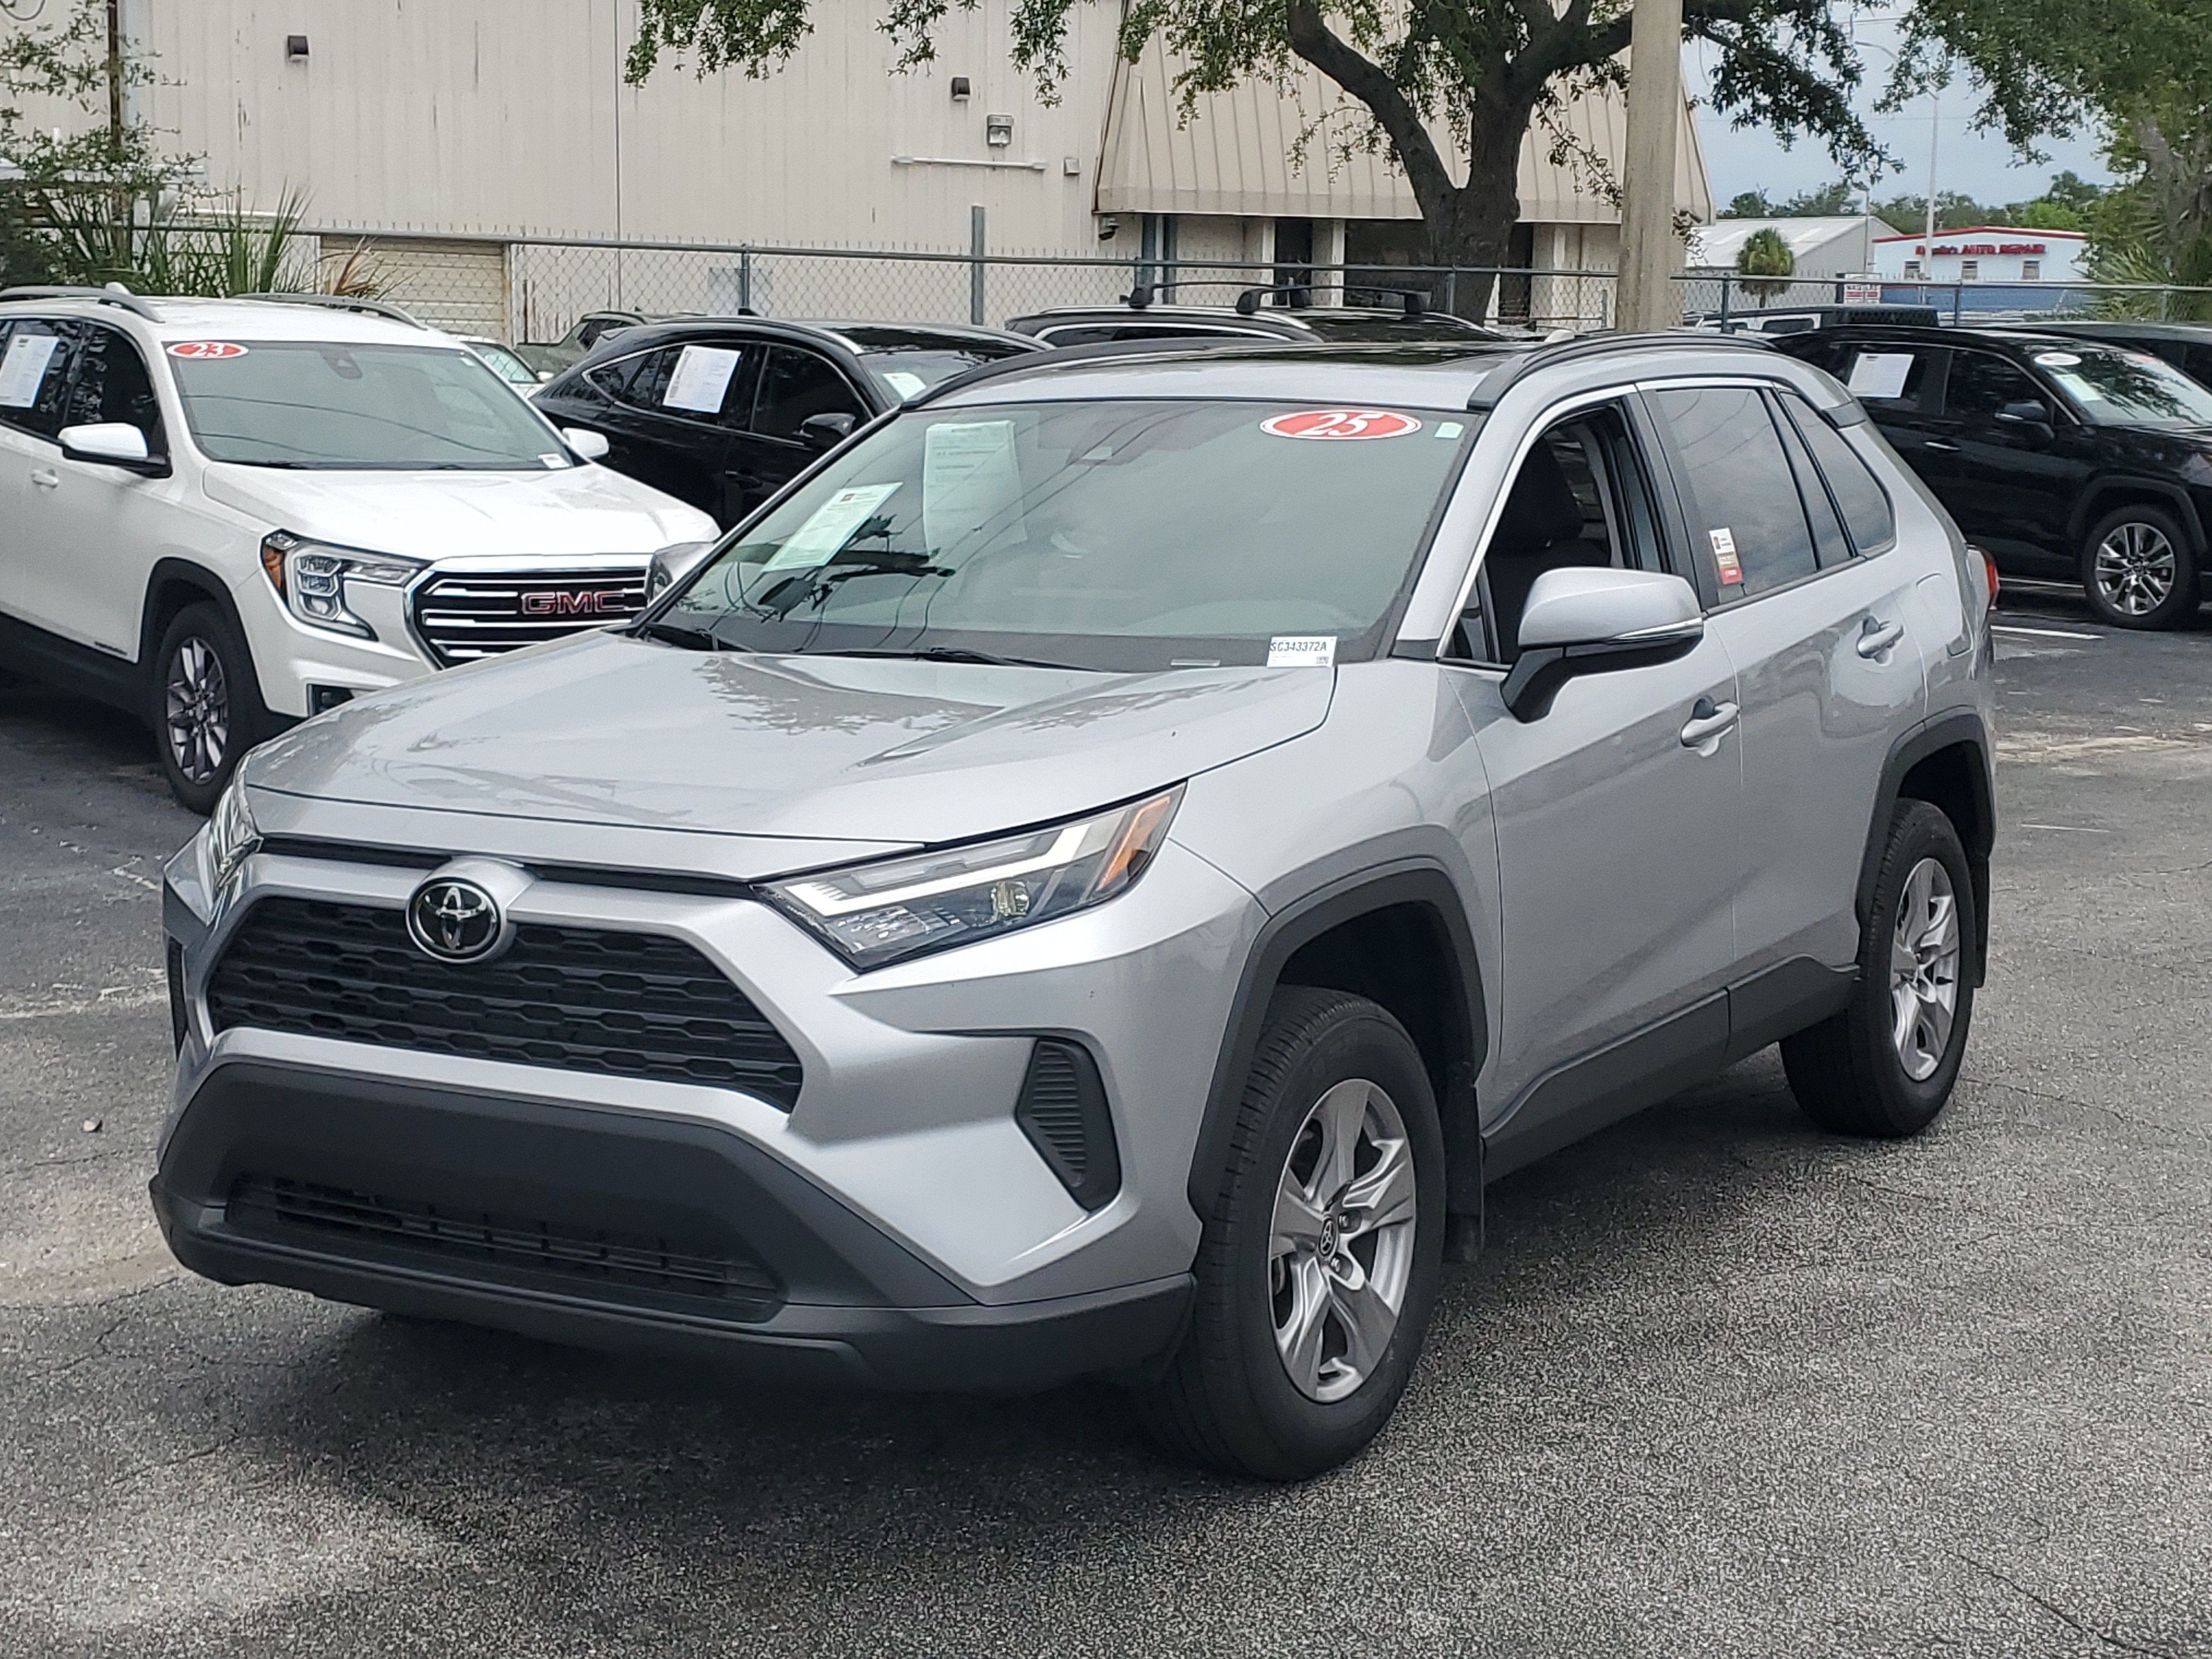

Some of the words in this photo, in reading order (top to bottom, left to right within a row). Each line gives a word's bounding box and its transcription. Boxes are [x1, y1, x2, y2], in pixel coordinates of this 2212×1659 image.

[190, 343, 225, 357] 23
[1295, 413, 1385, 436] 25
[521, 590, 624, 614] GMC
[1269, 641, 1327, 652] SC343372A
